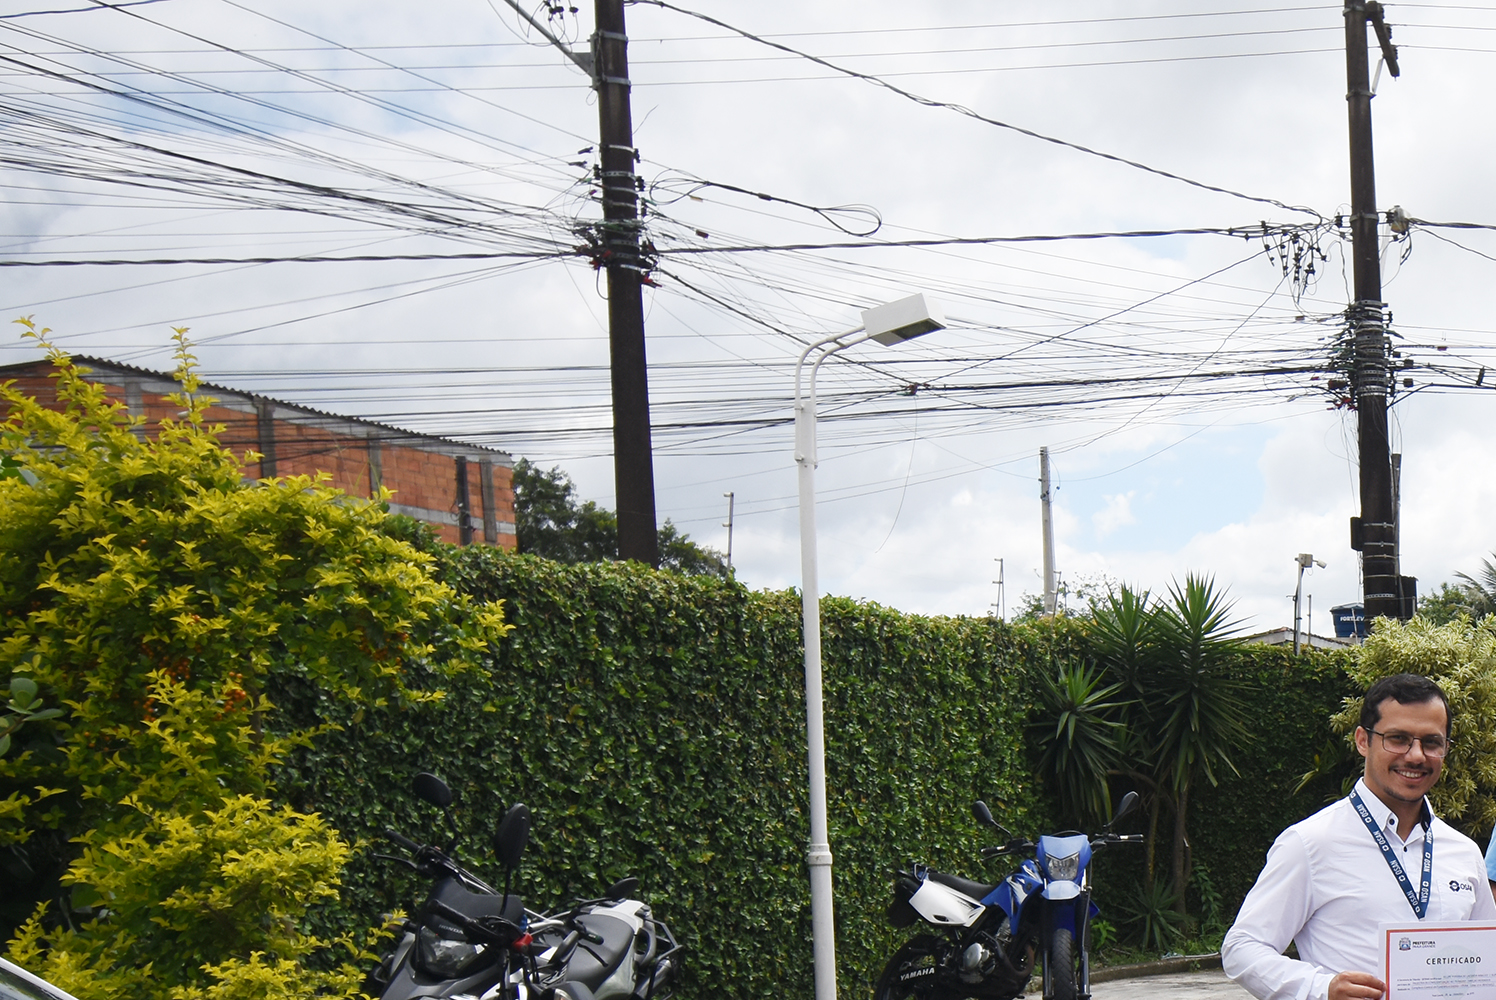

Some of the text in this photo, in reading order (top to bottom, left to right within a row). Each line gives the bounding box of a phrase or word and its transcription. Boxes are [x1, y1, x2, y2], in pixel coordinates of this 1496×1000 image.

[1356, 803, 1368, 819] OSAN
[1373, 830, 1385, 848] OSAN
[1390, 860, 1403, 876] OSAN
[1426, 957, 1481, 965] CERTIFICADO
[900, 967, 935, 981] YAMAHA
